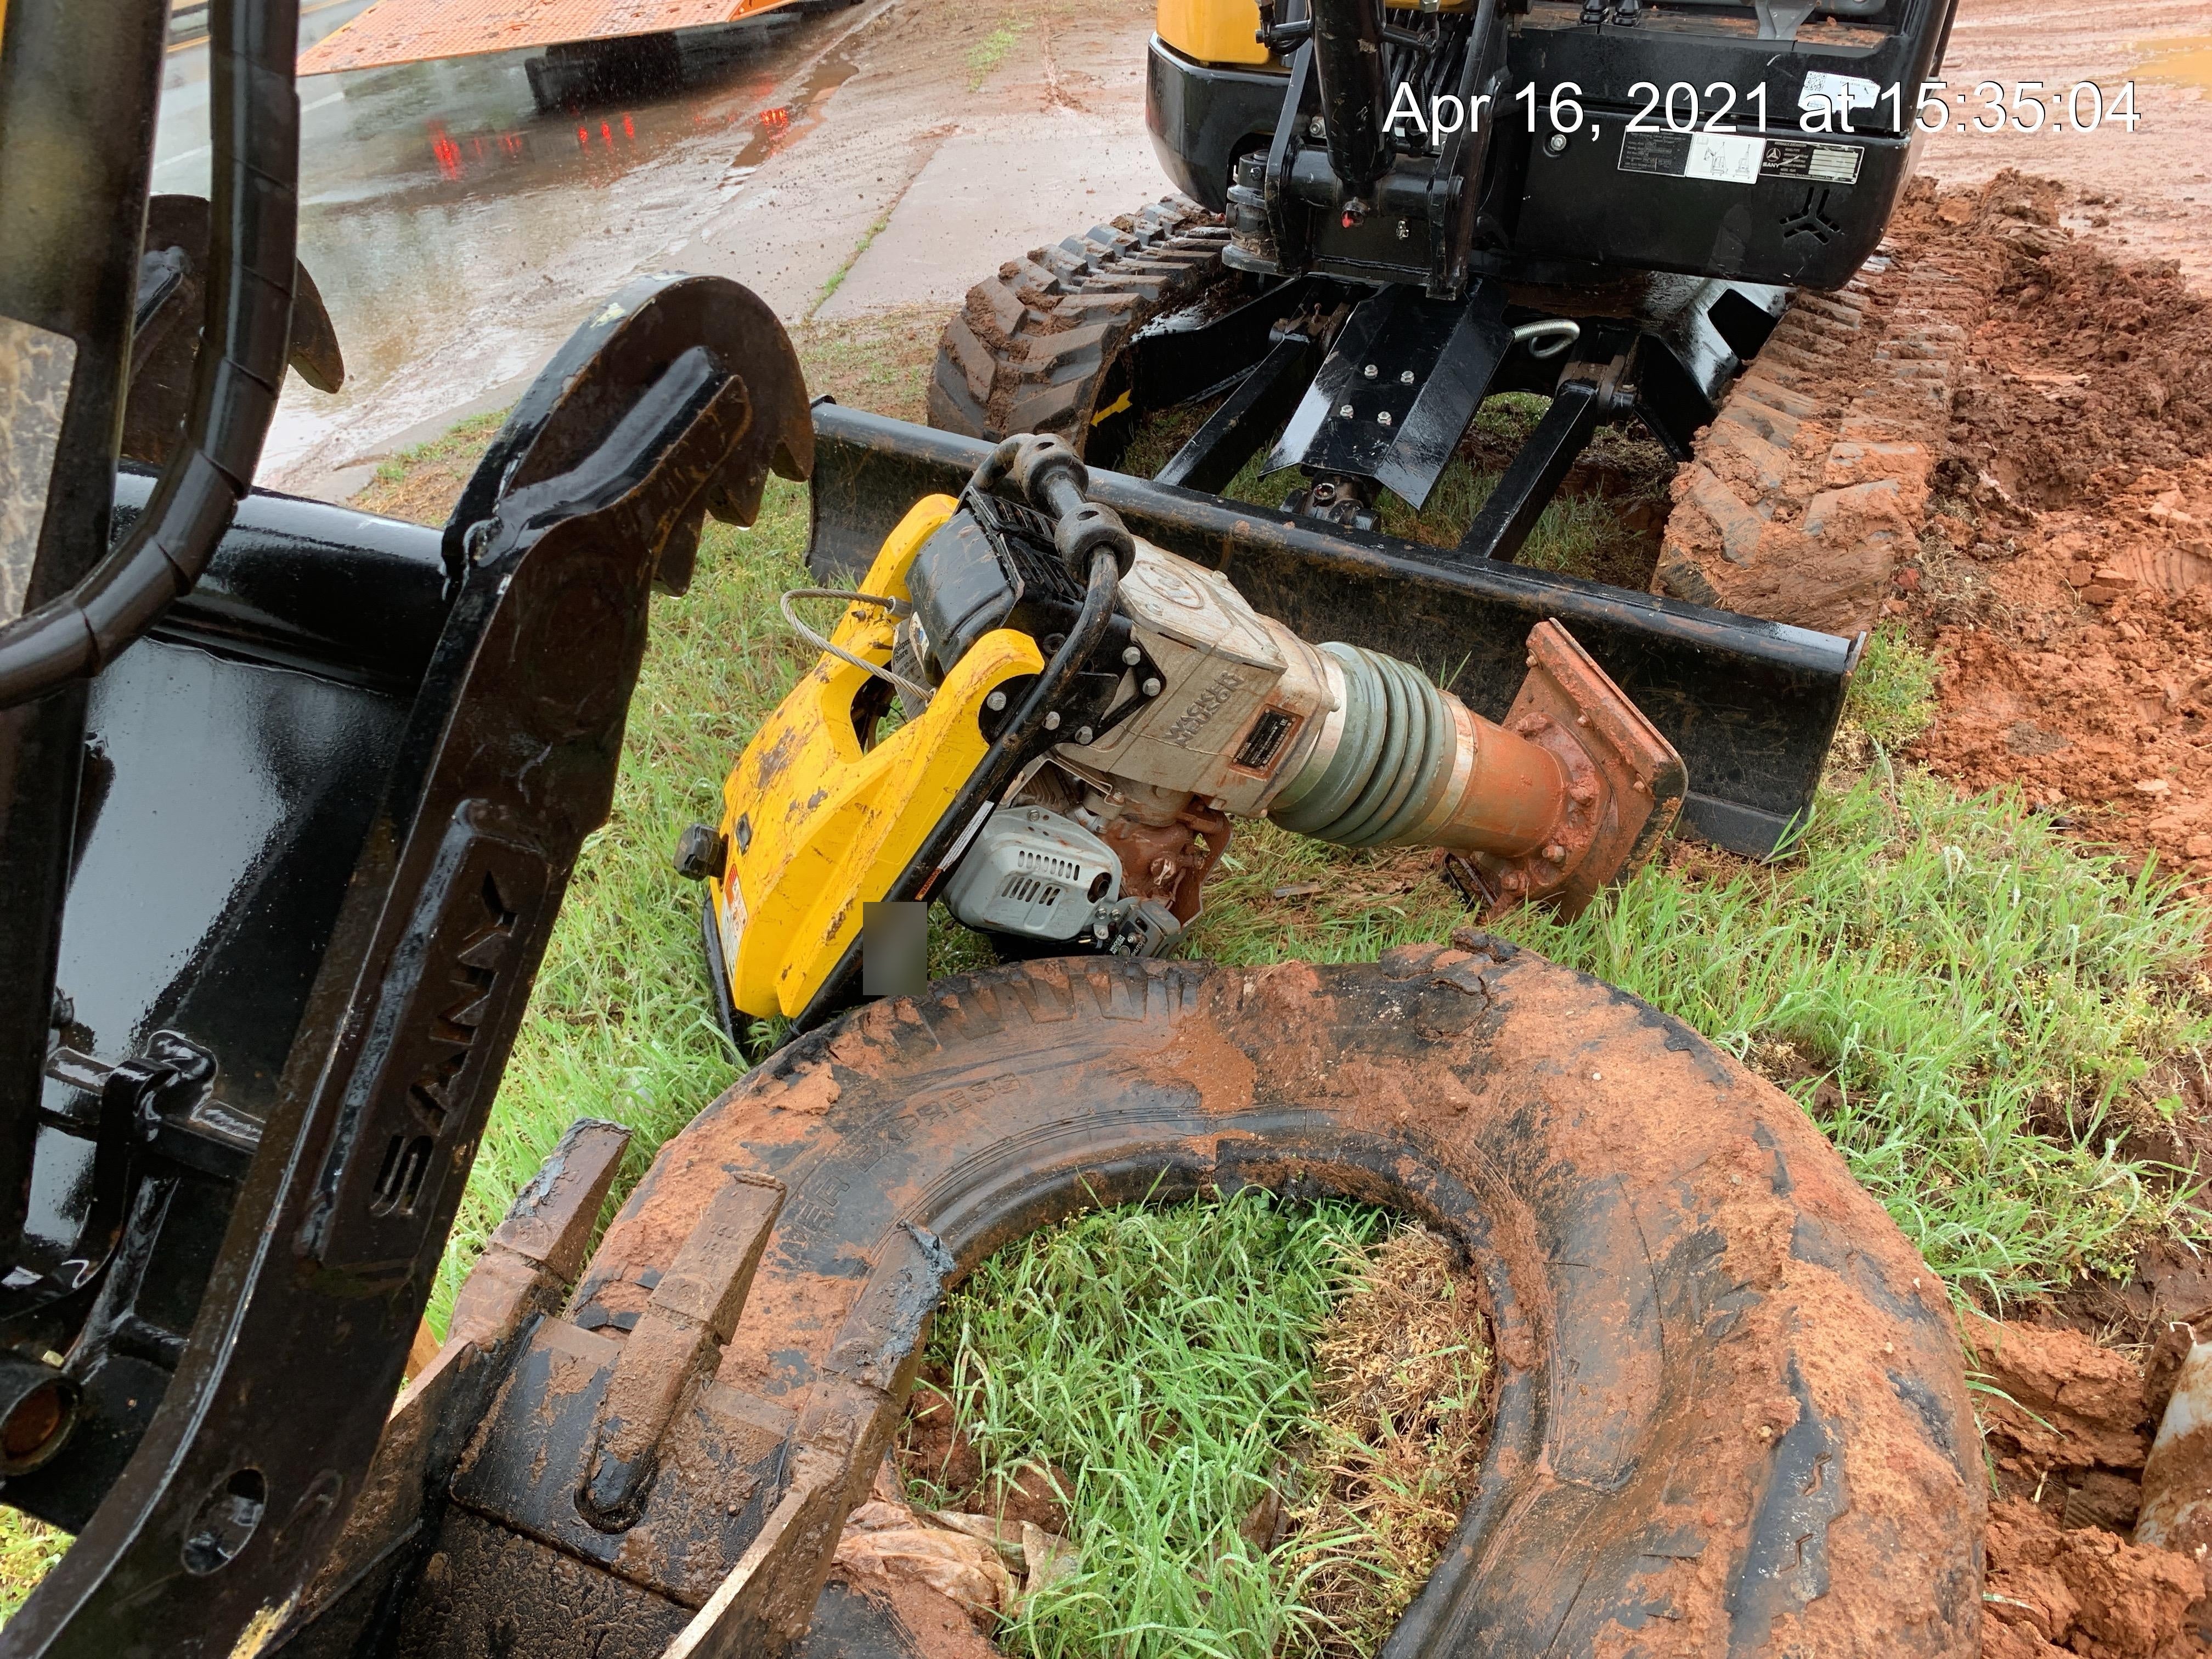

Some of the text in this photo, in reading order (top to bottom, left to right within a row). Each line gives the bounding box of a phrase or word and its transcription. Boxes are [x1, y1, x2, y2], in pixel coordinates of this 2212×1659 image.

[1163, 670, 1235, 741] WACKER
[1175, 674, 1245, 748] NEUSON
[370, 870, 520, 1217] SANY
